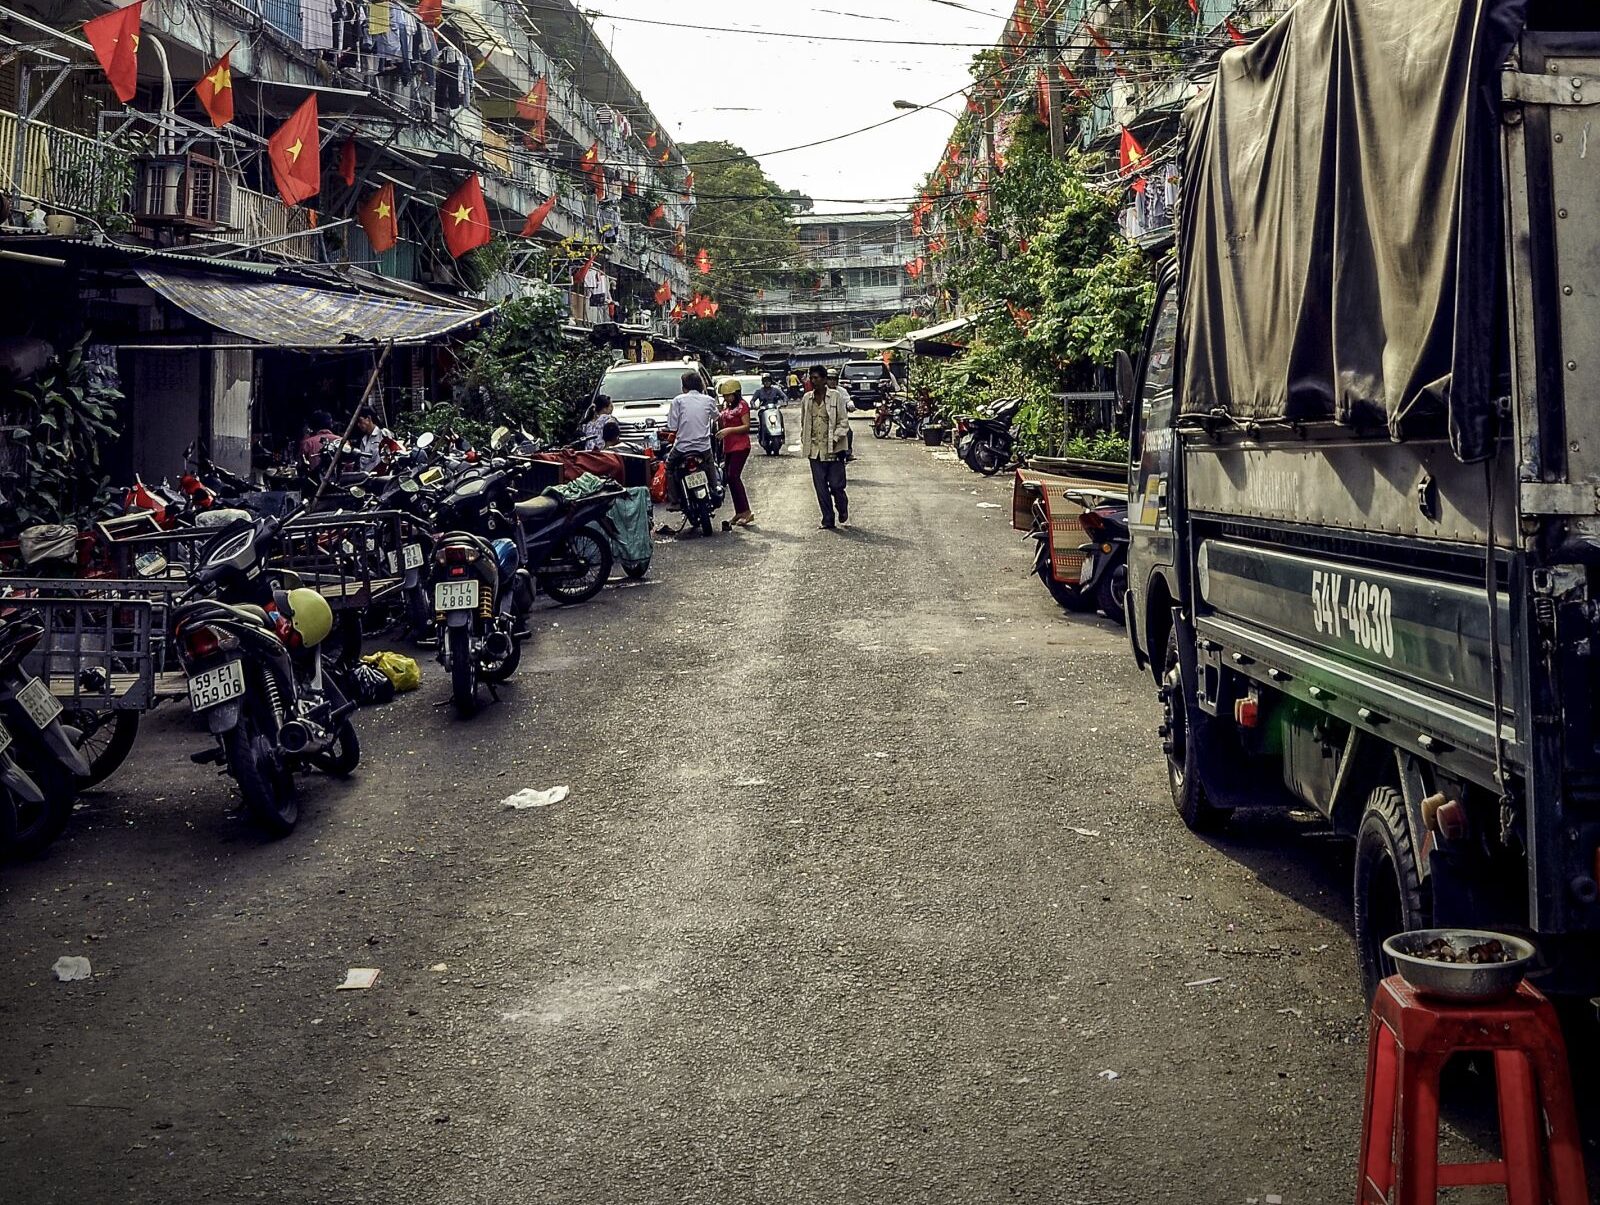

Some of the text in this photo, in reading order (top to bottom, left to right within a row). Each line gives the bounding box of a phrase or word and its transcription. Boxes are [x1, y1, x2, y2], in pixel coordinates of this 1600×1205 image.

[441, 595, 472, 608] 4889
[442, 583, 472, 595] 51-L4
[1312, 570, 1394, 659] 54Y-4830
[195, 666, 232, 691] 59-E1
[193, 679, 241, 708] 059.06
